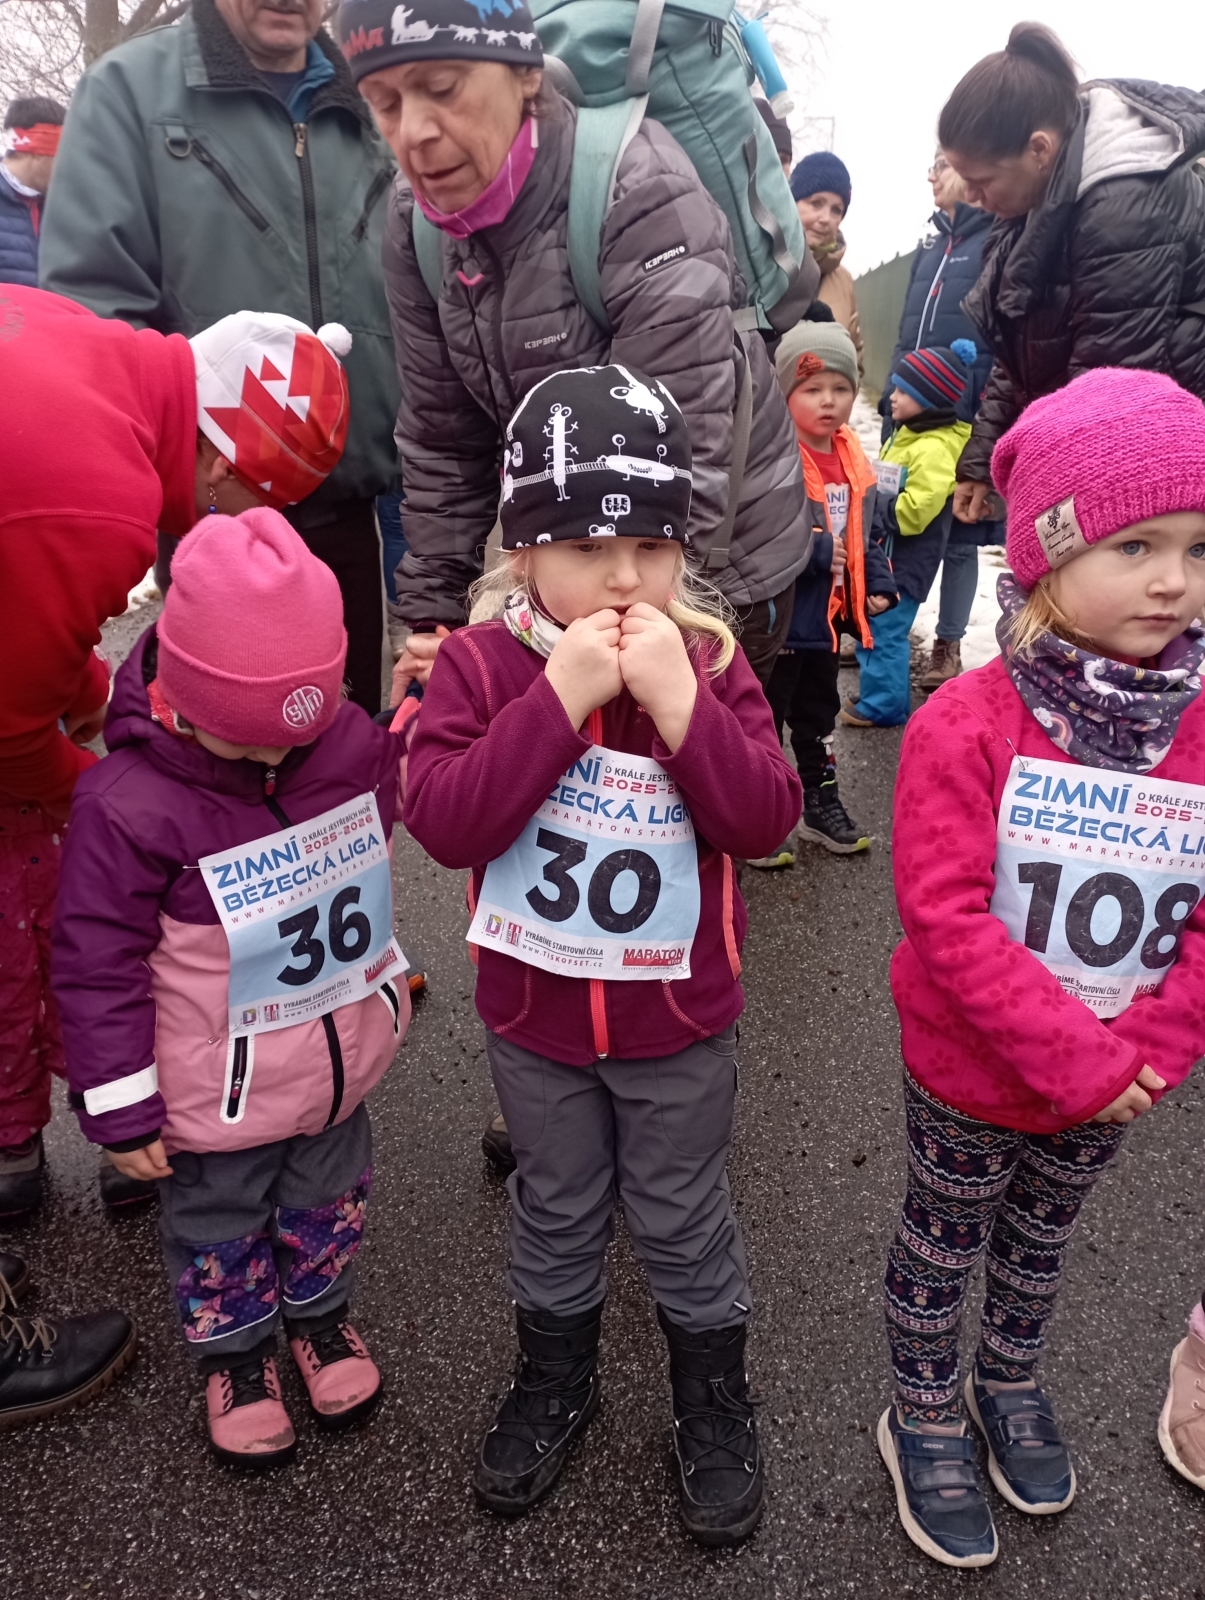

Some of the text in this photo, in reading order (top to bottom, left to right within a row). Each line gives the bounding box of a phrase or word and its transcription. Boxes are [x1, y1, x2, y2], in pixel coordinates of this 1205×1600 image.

[605, 765, 611, 774] O
[614, 767, 644, 781] KRÁLE
[1014, 771, 1133, 814] ZIMNÍ
[1138, 792, 1146, 800] O
[1148, 793, 1178, 808] KRÁLE
[302, 836, 308, 844] O
[309, 828, 328, 842] KRÁLE
[328, 810, 359, 833] JESTŘEBÍCH
[304, 814, 373, 855] 2025-2026
[1009, 805, 1171, 851] BĚŽECKÁ
[212, 835, 301, 890] ZIMNÍ
[222, 833, 380, 913] BĚŽECKÁ LIGA
[525, 827, 661, 934] 30
[276, 886, 371, 986] 36
[1017, 861, 1200, 970] 108
[525, 930, 552, 947] VYRÁBÍME
[552, 942, 586, 955] STARTOVNÍ
[587, 947, 603, 956] ČÍSLA
[624, 947, 685, 959] MARATON
[284, 979, 350, 1009] VYRÁBÍME STARTOVNÍ ČÍSLA
[1107, 987, 1121, 995] ČÍSLA
